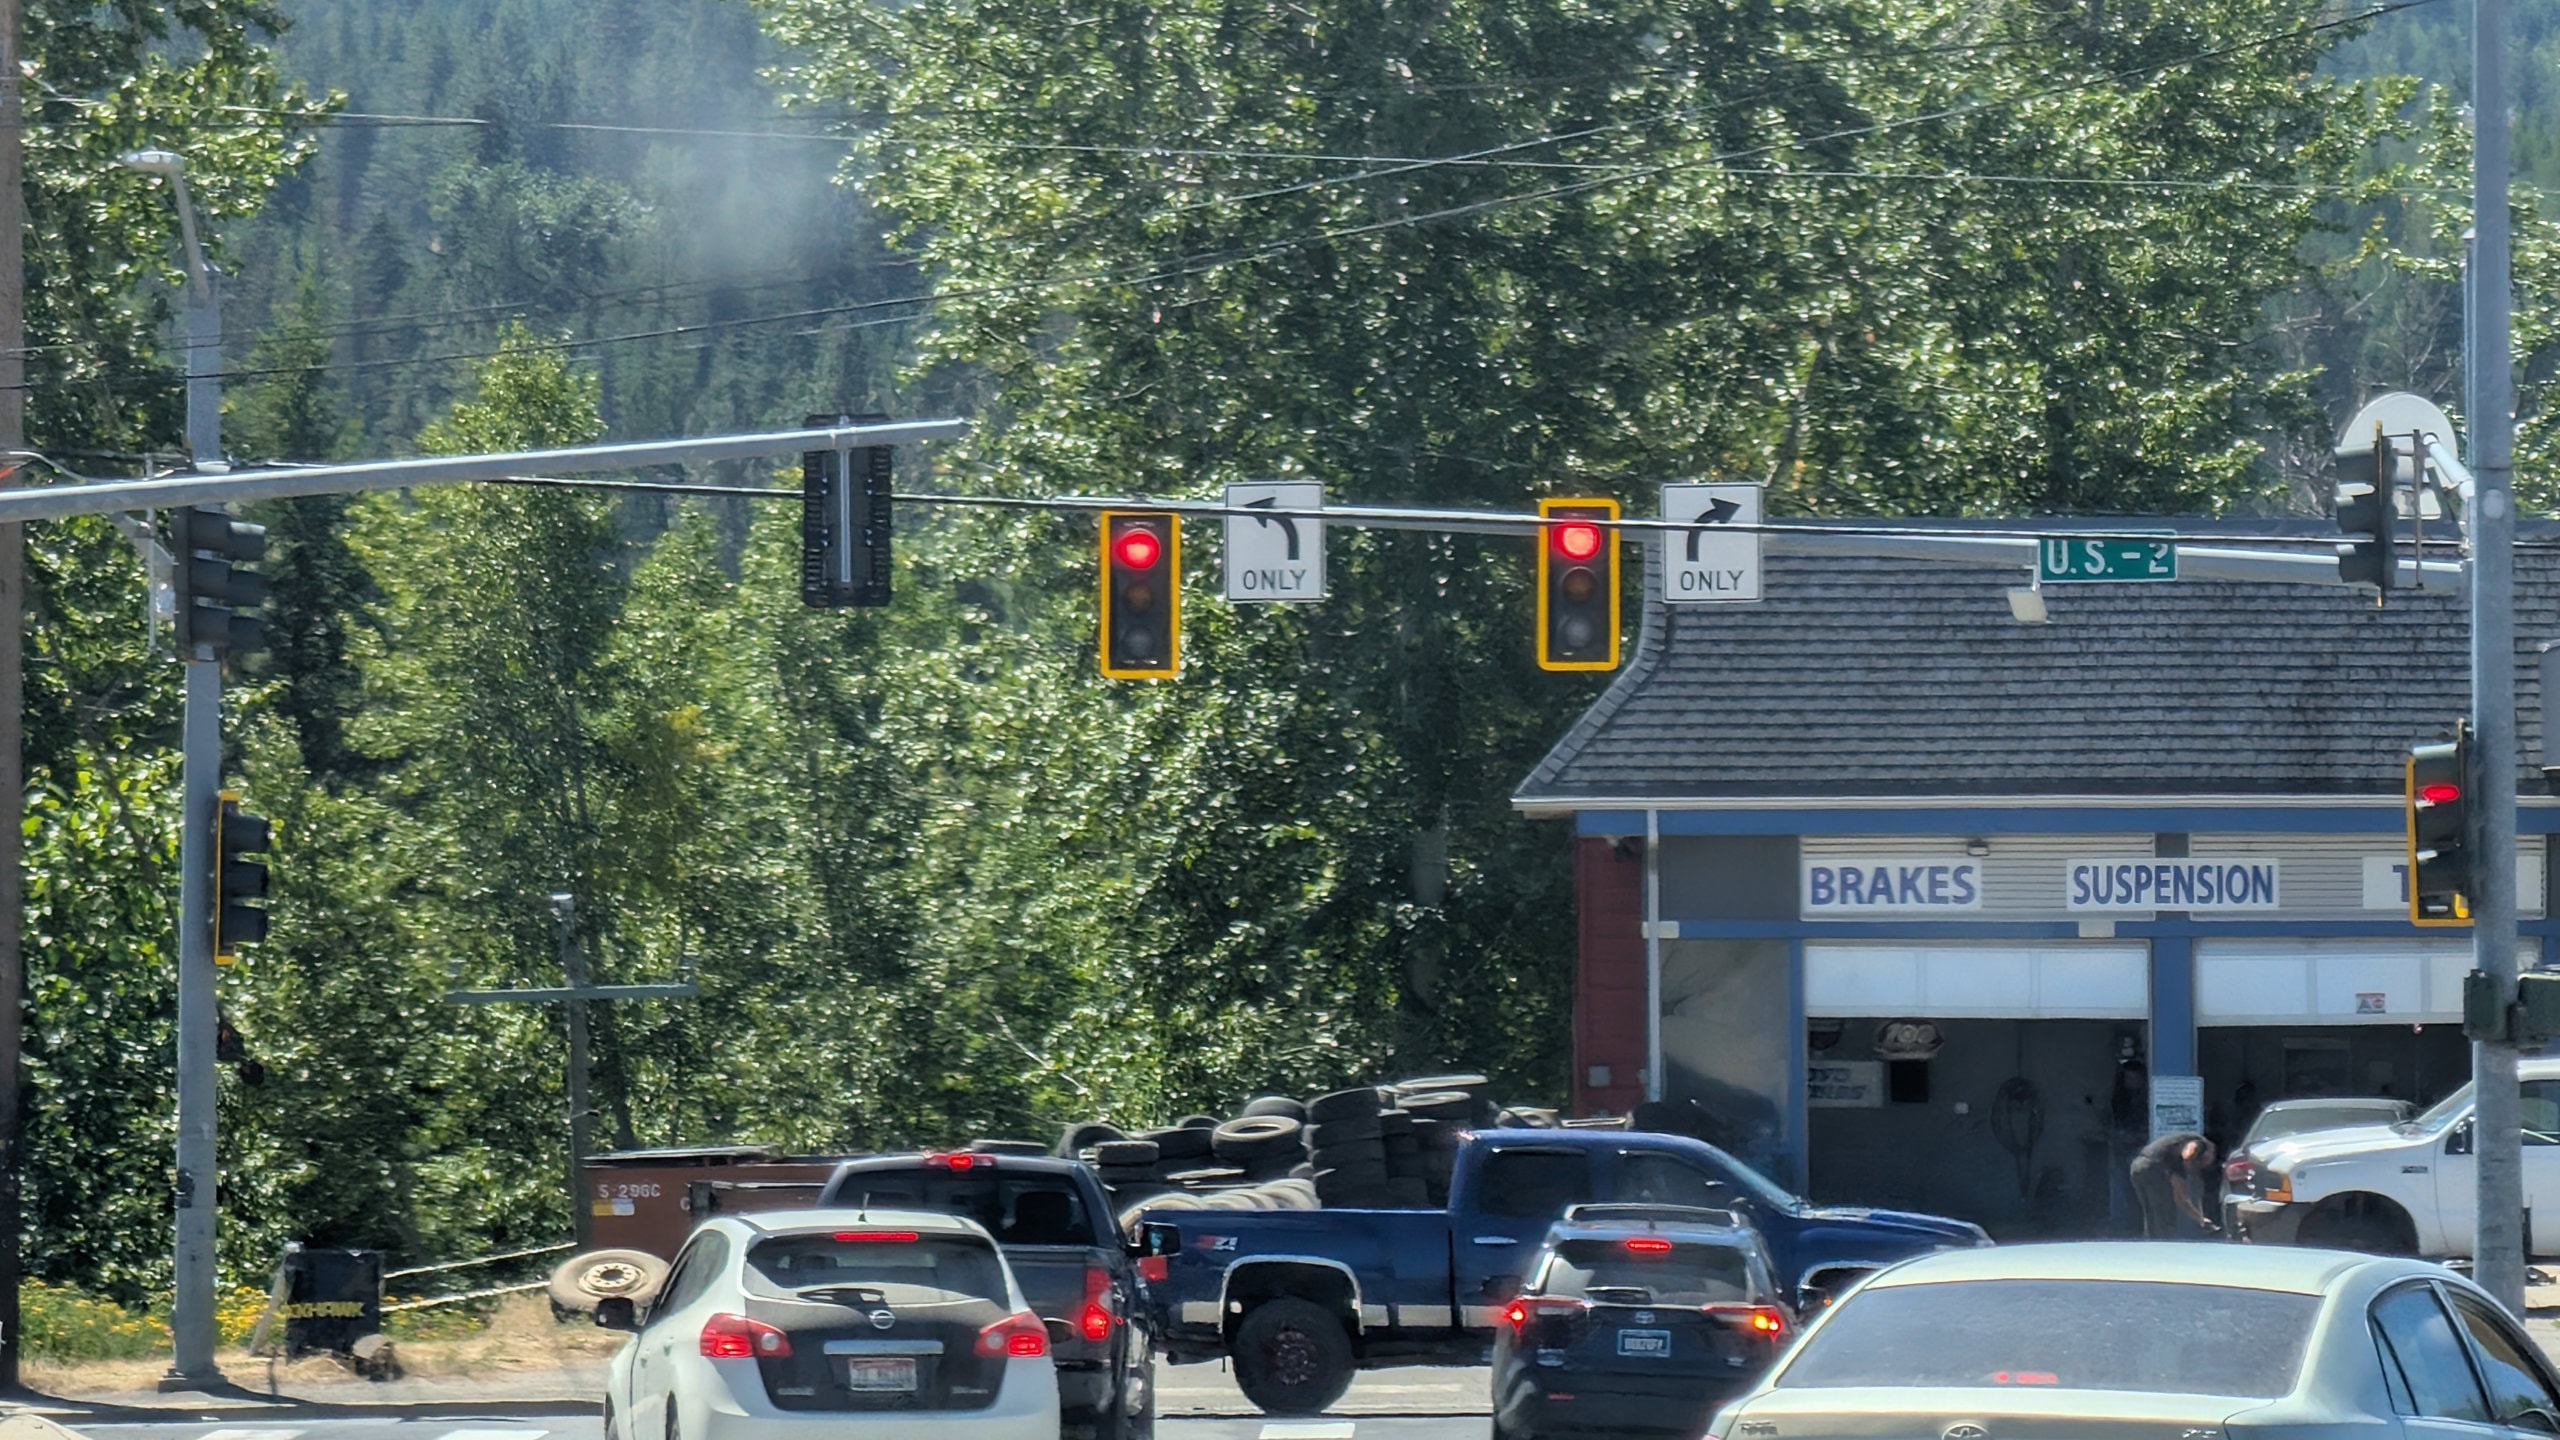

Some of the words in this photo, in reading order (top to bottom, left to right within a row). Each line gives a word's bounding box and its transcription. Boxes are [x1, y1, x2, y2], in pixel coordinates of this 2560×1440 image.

[1243, 569, 1306, 591] ONLY
[1680, 570, 1744, 592] ONLY
[1811, 865, 1976, 905] BRAKES
[2073, 864, 2274, 905] SUSPENSION
